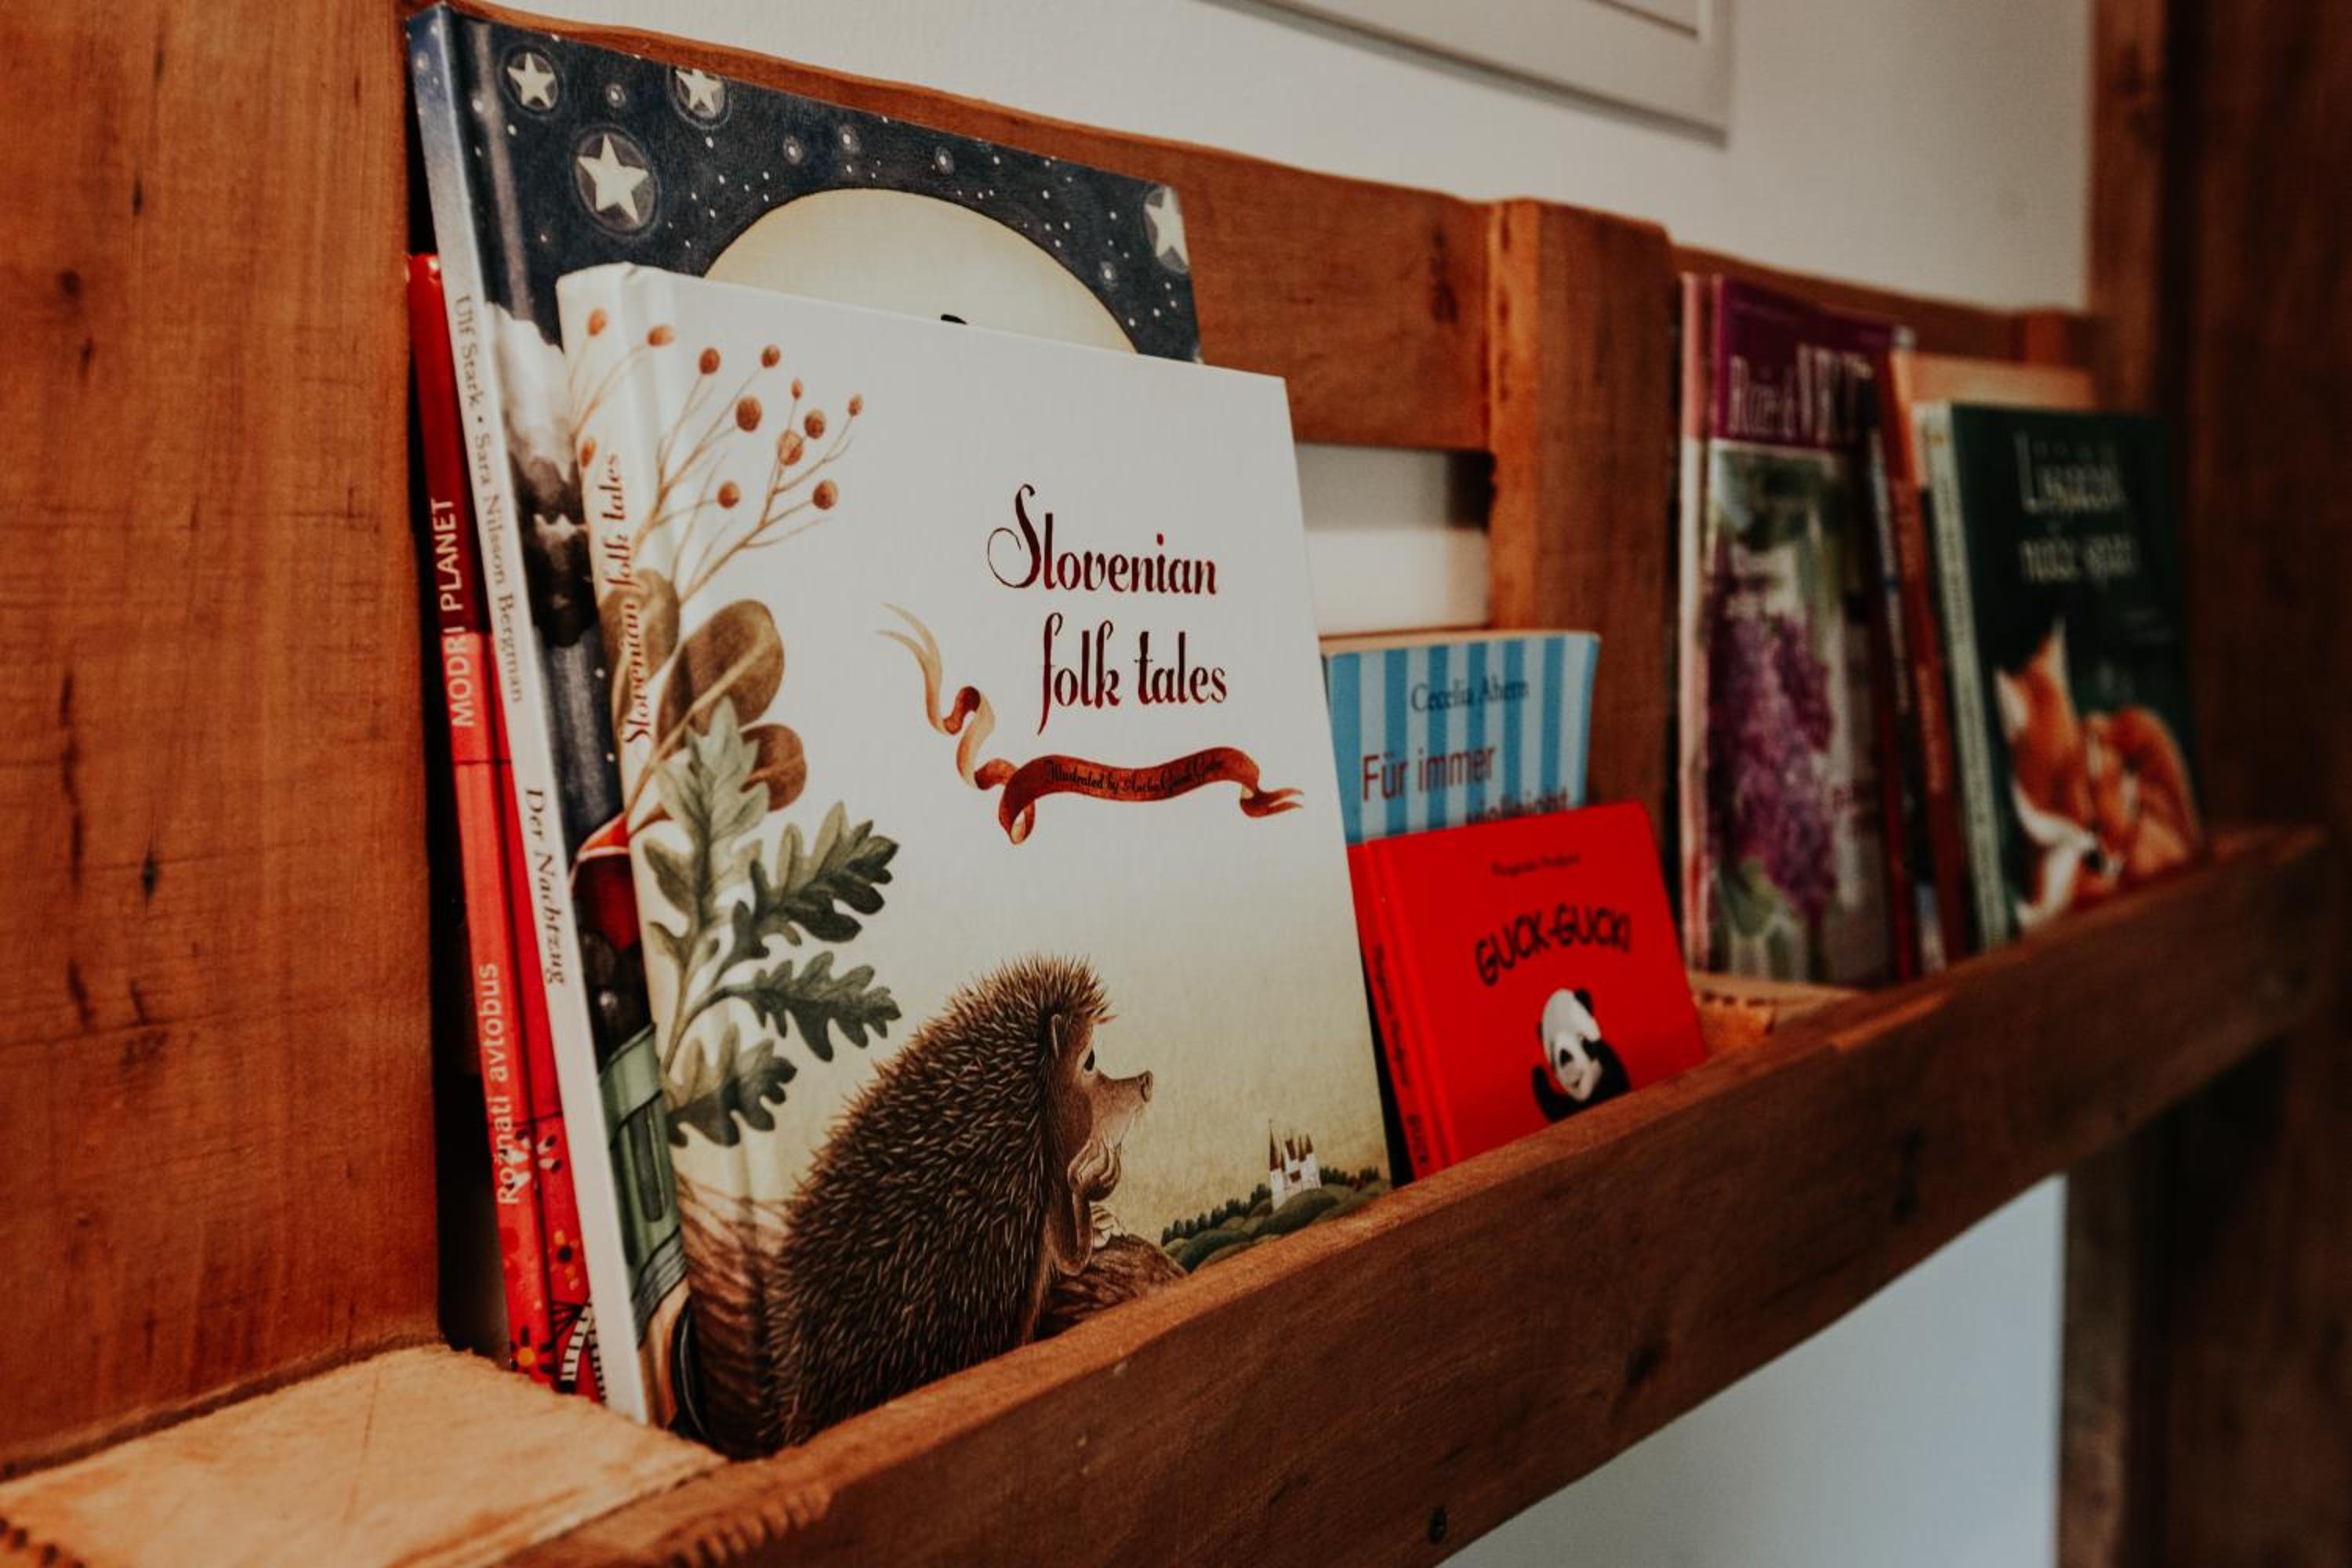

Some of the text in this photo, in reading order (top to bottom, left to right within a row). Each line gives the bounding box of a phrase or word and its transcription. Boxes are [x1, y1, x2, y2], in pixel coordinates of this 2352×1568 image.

[455, 295, 523, 702] Ulf Stark Sara Nilsson Bergman
[598, 453, 626, 520] tales
[987, 483, 1218, 595] Slovenian
[430, 497, 473, 728] MODRI PLANET
[1037, 612, 1228, 736] folk tales
[1362, 744, 1496, 802] Für immer
[524, 789, 565, 985] Der Nachtzug
[479, 963, 510, 1082] avtobus
